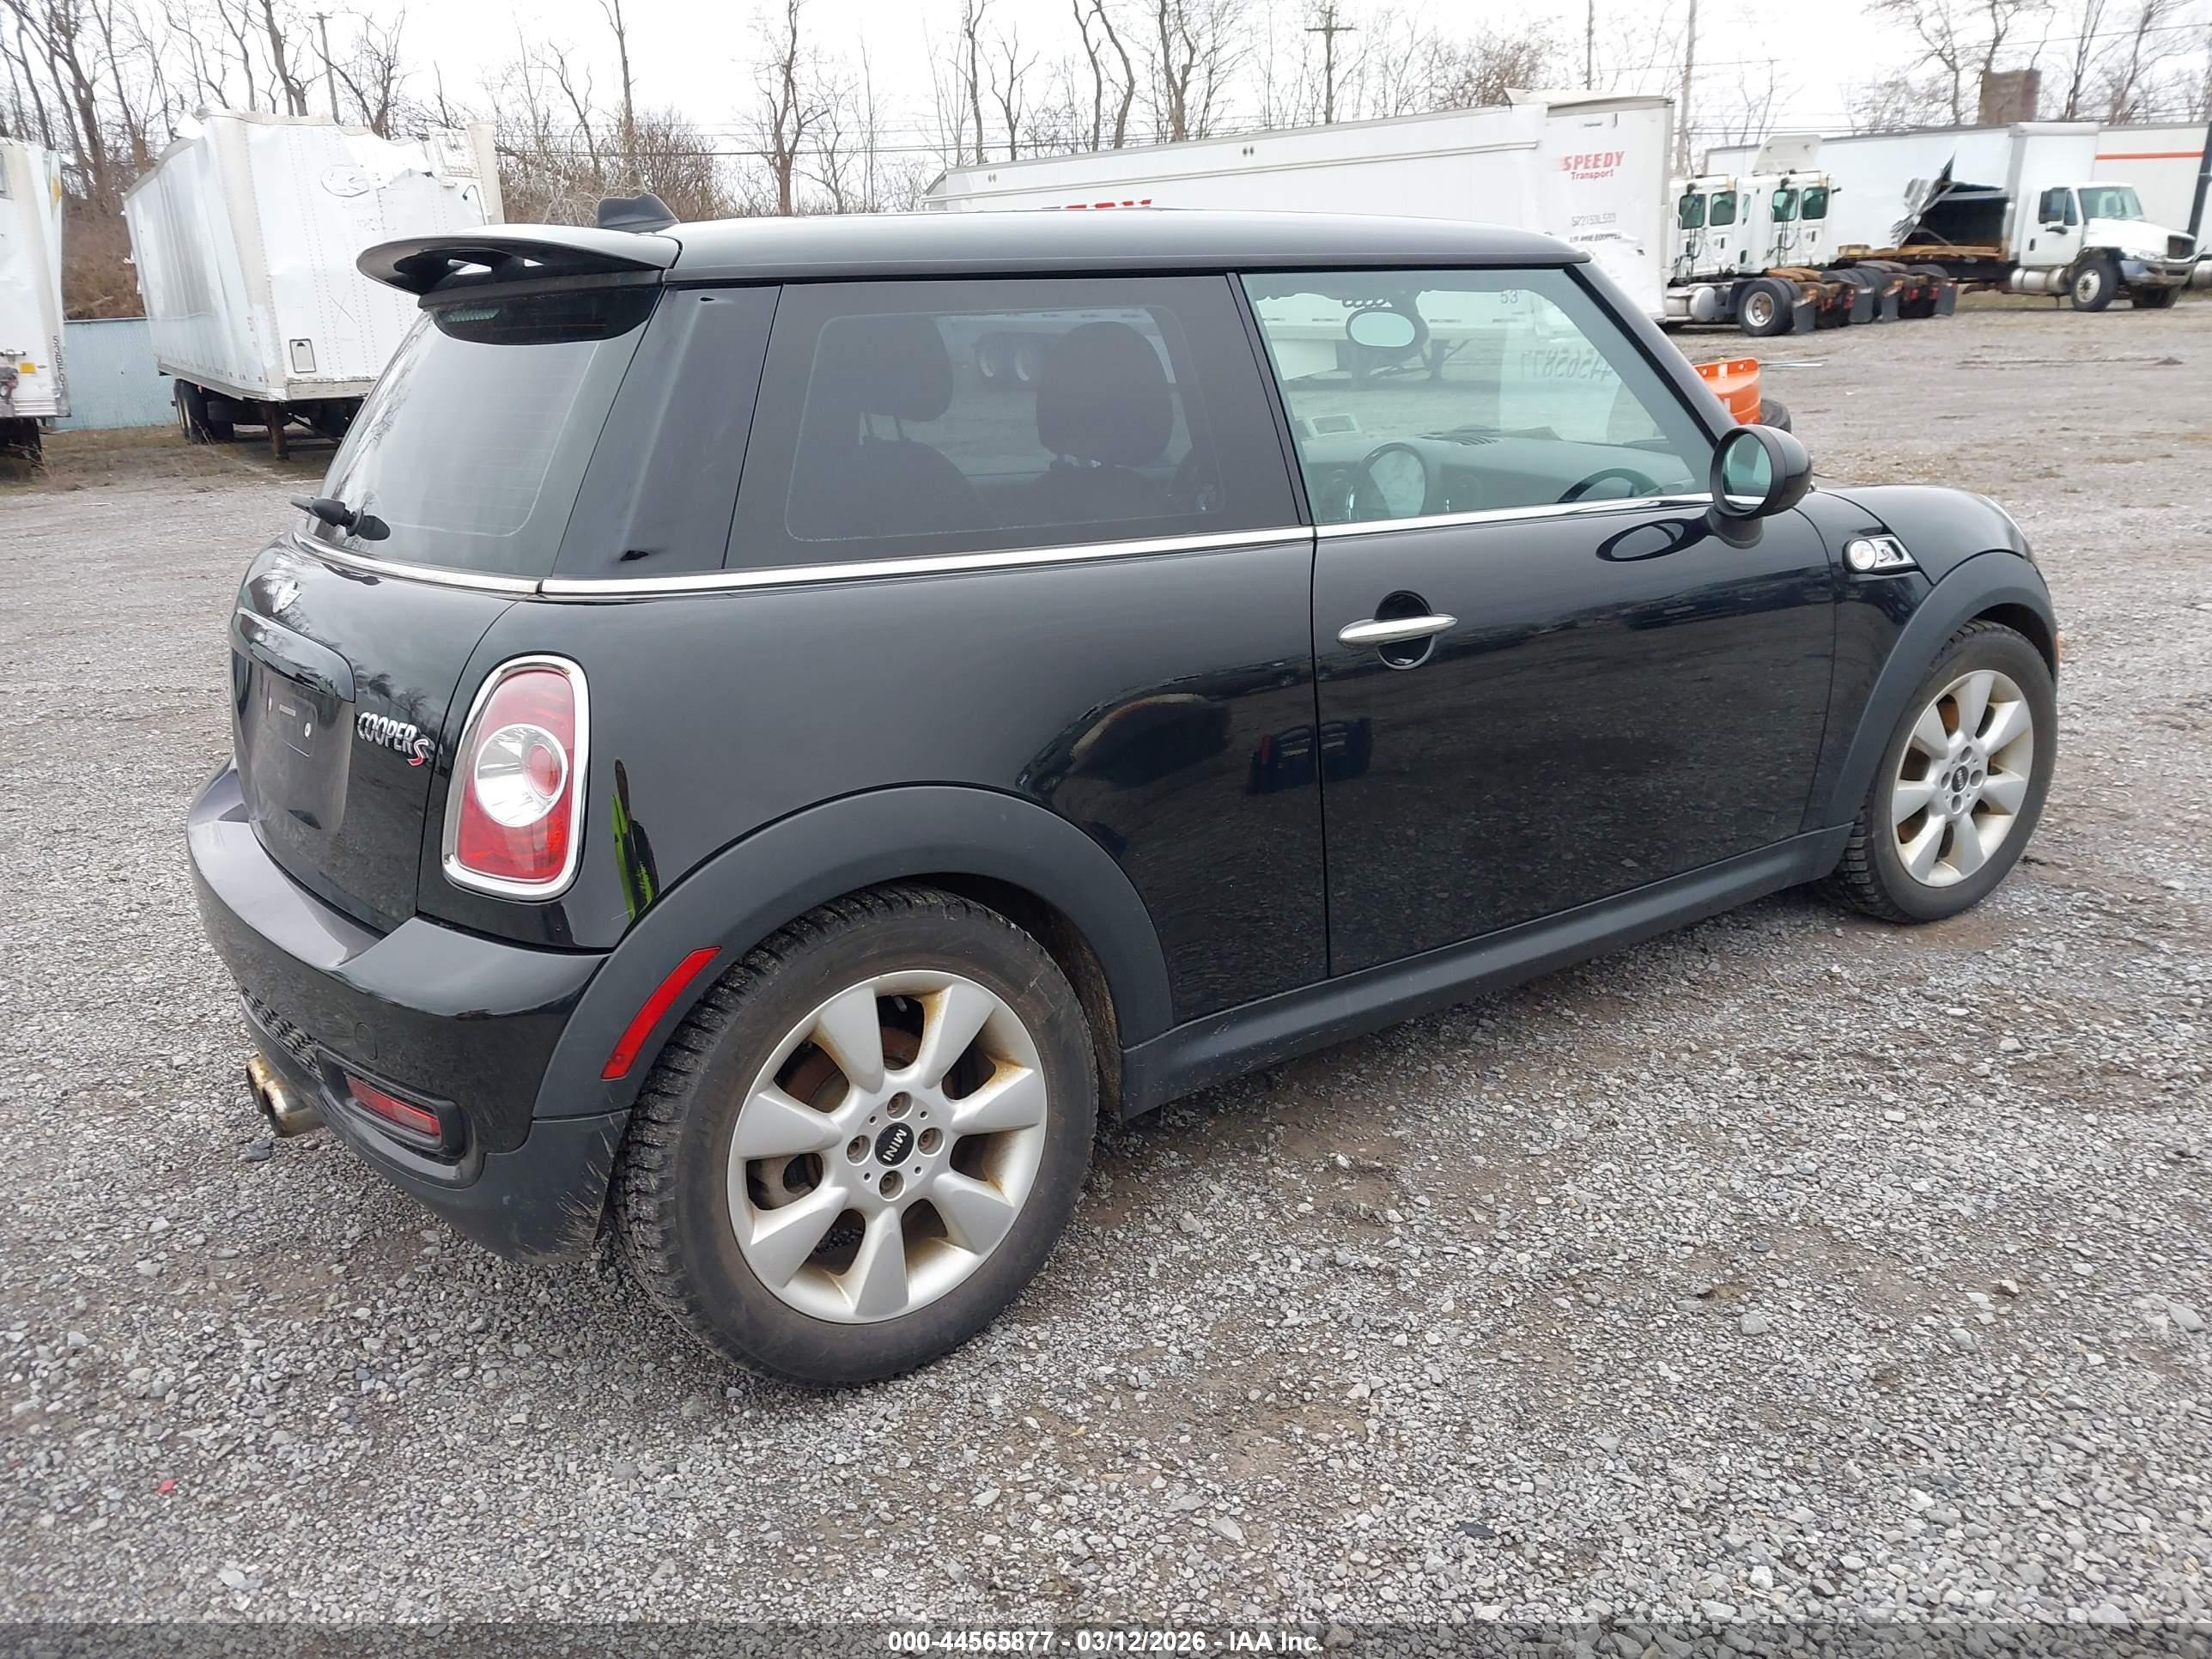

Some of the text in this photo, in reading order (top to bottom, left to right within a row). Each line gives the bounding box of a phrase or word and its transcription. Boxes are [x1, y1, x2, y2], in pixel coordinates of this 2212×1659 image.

[1563, 151, 1625, 171] SPEEDY
[1571, 169, 1614, 180] Transport
[357, 712, 429, 766] COOPER S
[883, 1129, 908, 1162] MINI
